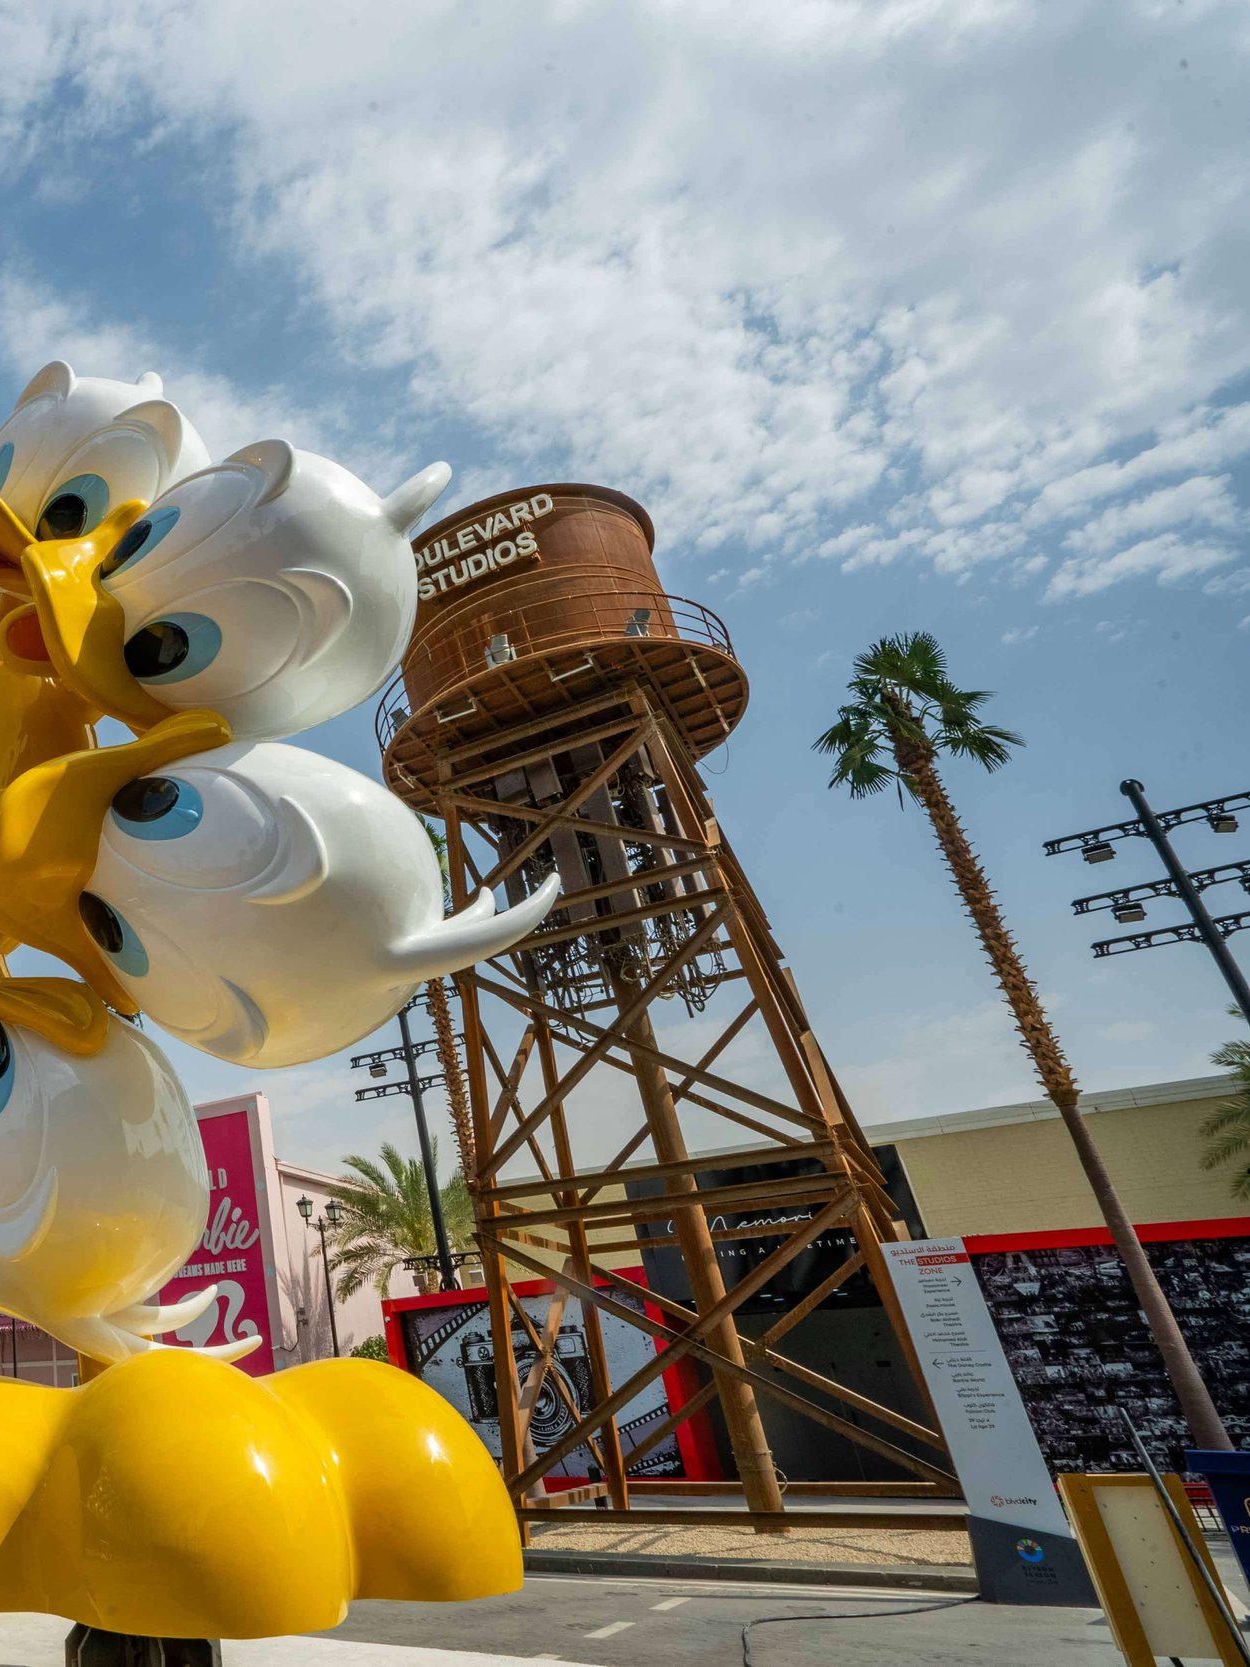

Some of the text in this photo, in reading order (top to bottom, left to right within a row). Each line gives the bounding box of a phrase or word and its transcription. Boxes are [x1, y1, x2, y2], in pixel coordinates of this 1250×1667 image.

[418, 531, 538, 601] STUDIOS
[899, 1255, 957, 1266] THE STUDIOS
[919, 1267, 943, 1275] ZONE
